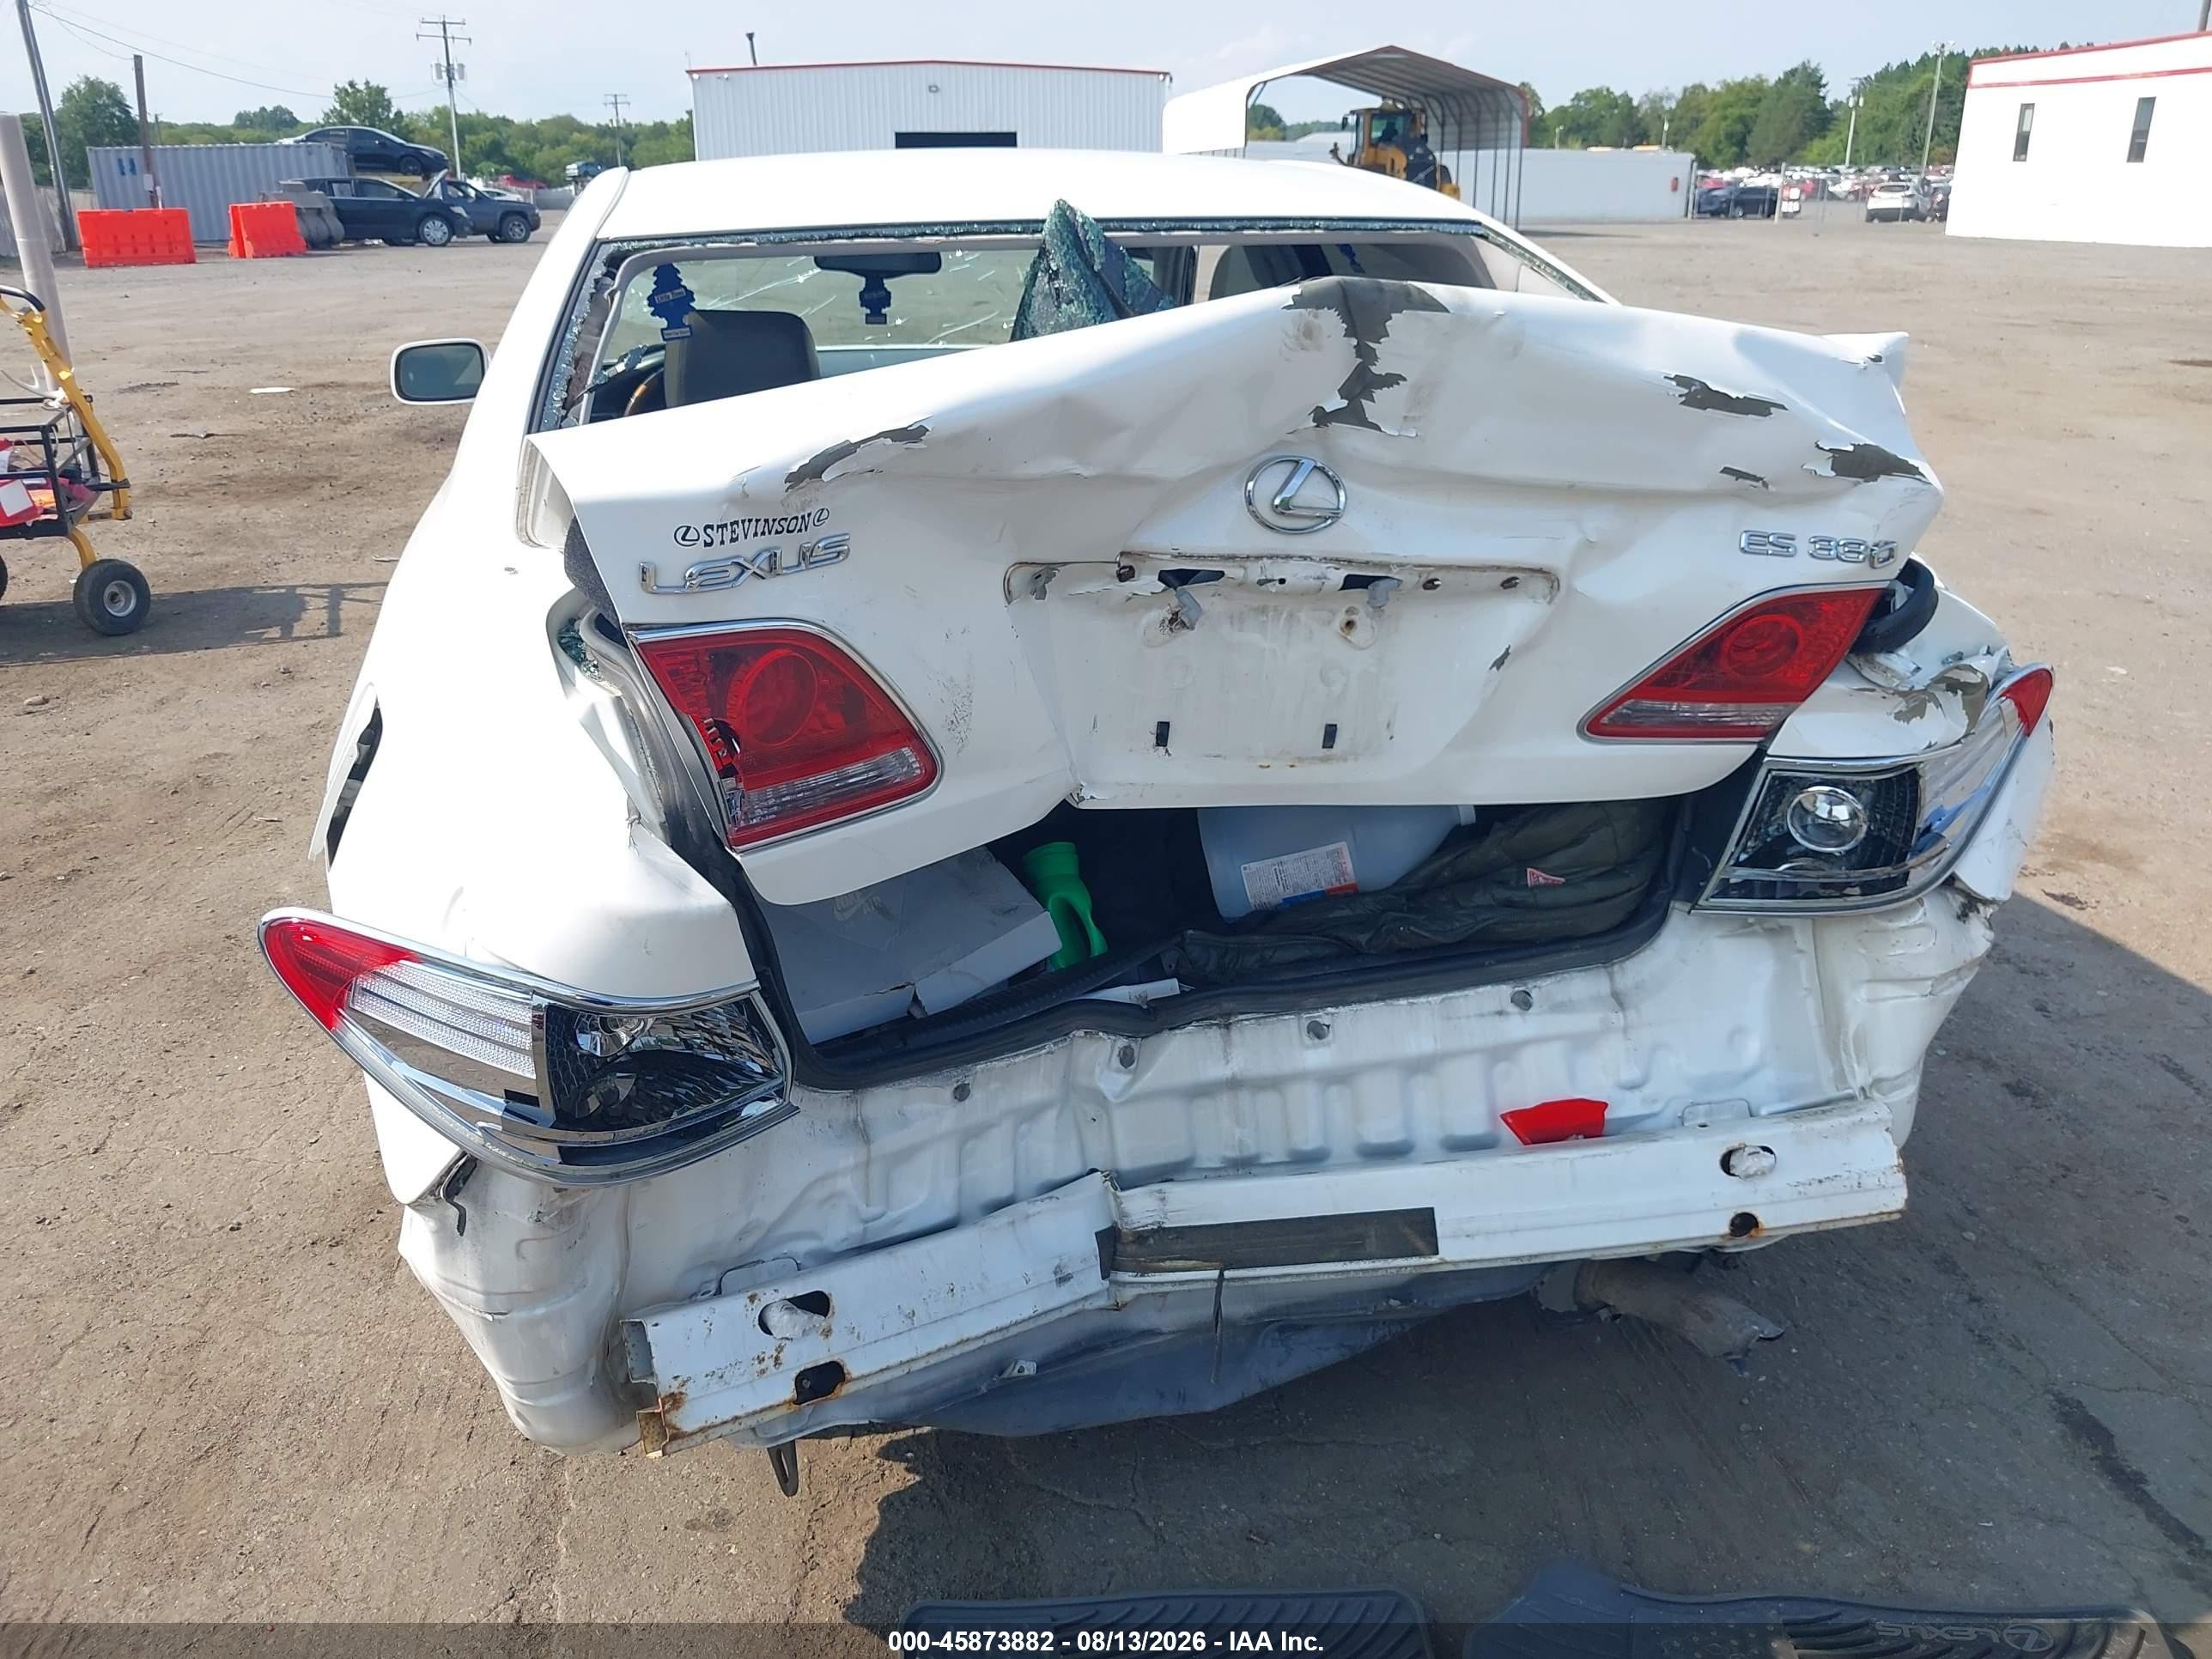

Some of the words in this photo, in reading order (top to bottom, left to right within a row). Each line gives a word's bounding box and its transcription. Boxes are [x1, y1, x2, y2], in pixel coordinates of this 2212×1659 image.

[703, 512, 812, 548] STEVINSON
[1739, 529, 1797, 558] ES
[638, 532, 851, 595] LEXUS
[1875, 1621, 2001, 1644] LEXUS
